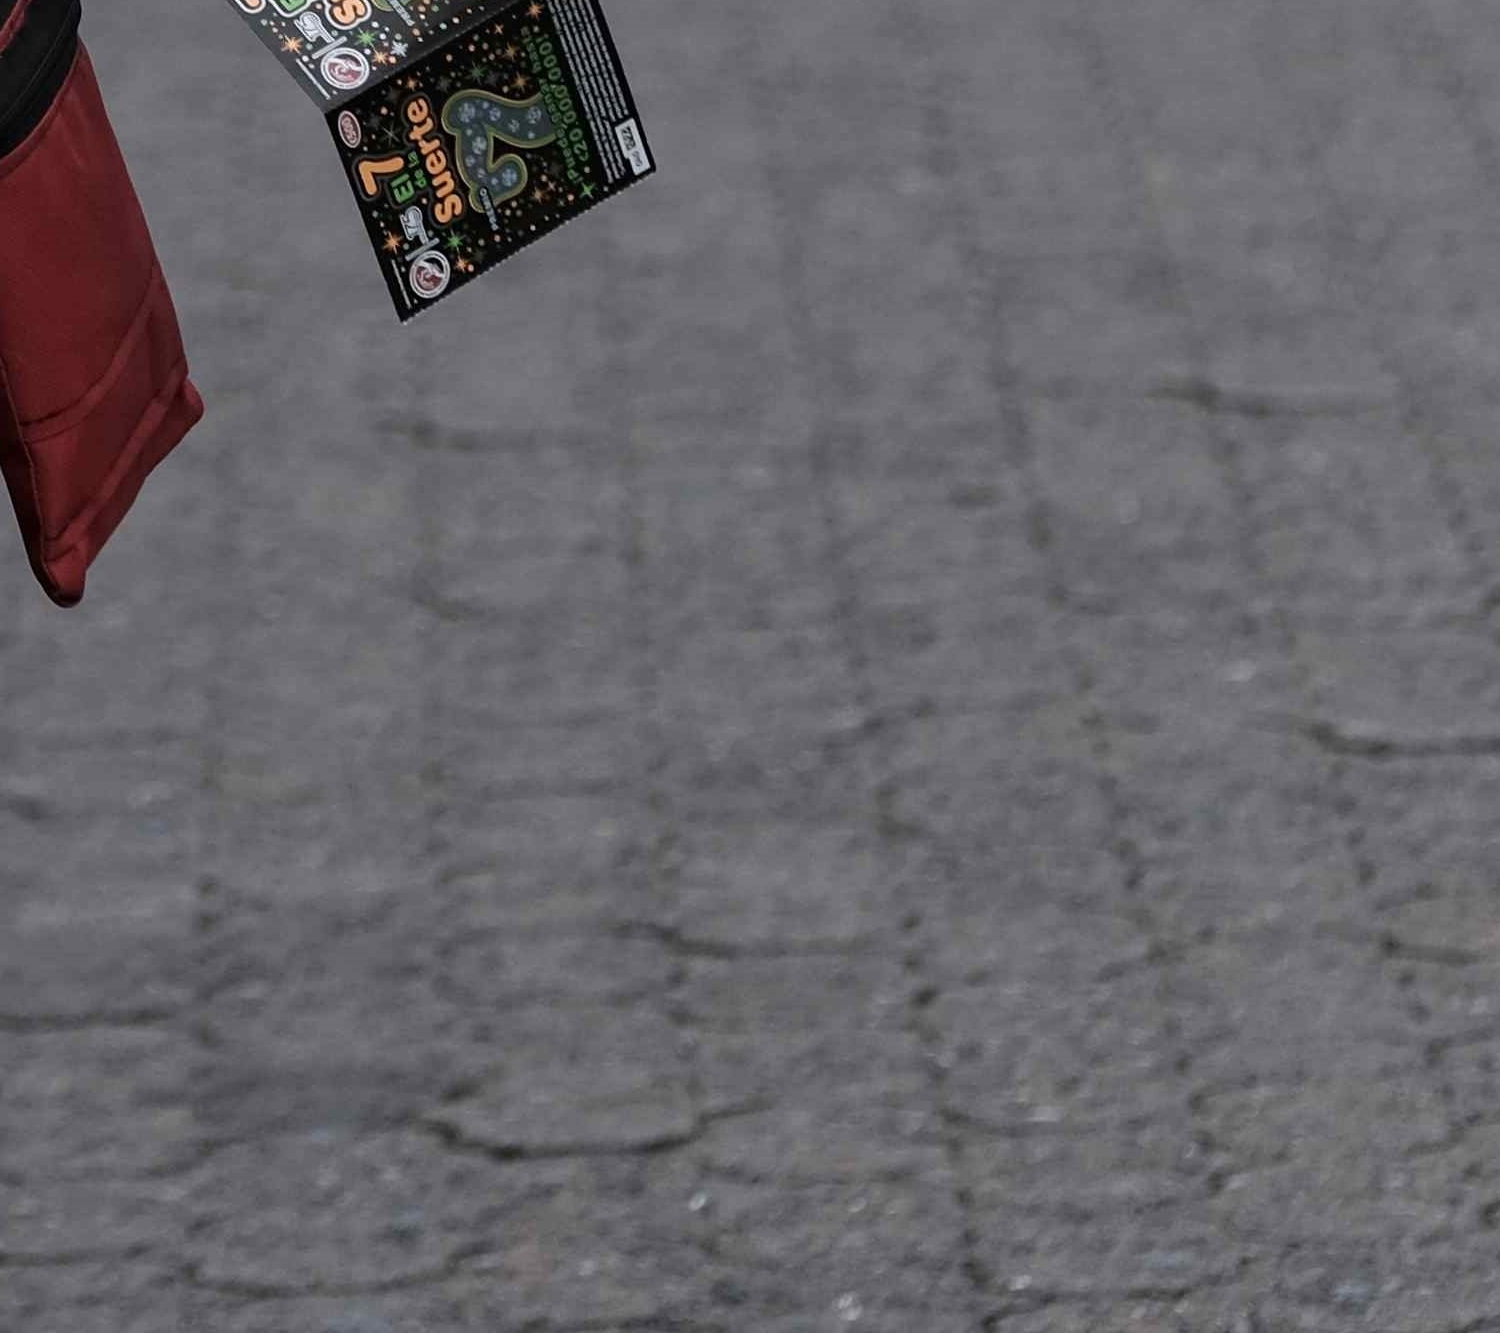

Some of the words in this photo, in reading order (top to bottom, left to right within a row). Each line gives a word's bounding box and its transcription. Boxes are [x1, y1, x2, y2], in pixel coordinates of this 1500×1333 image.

[518, 24, 543, 74] hasta
[536, 74, 563, 124] ganar
[358, 157, 404, 195] 7
[405, 150, 420, 168] la
[407, 98, 463, 223] Suerte
[411, 168, 427, 190] de
[390, 171, 415, 202] El
[478, 187, 500, 232] PREMIO
